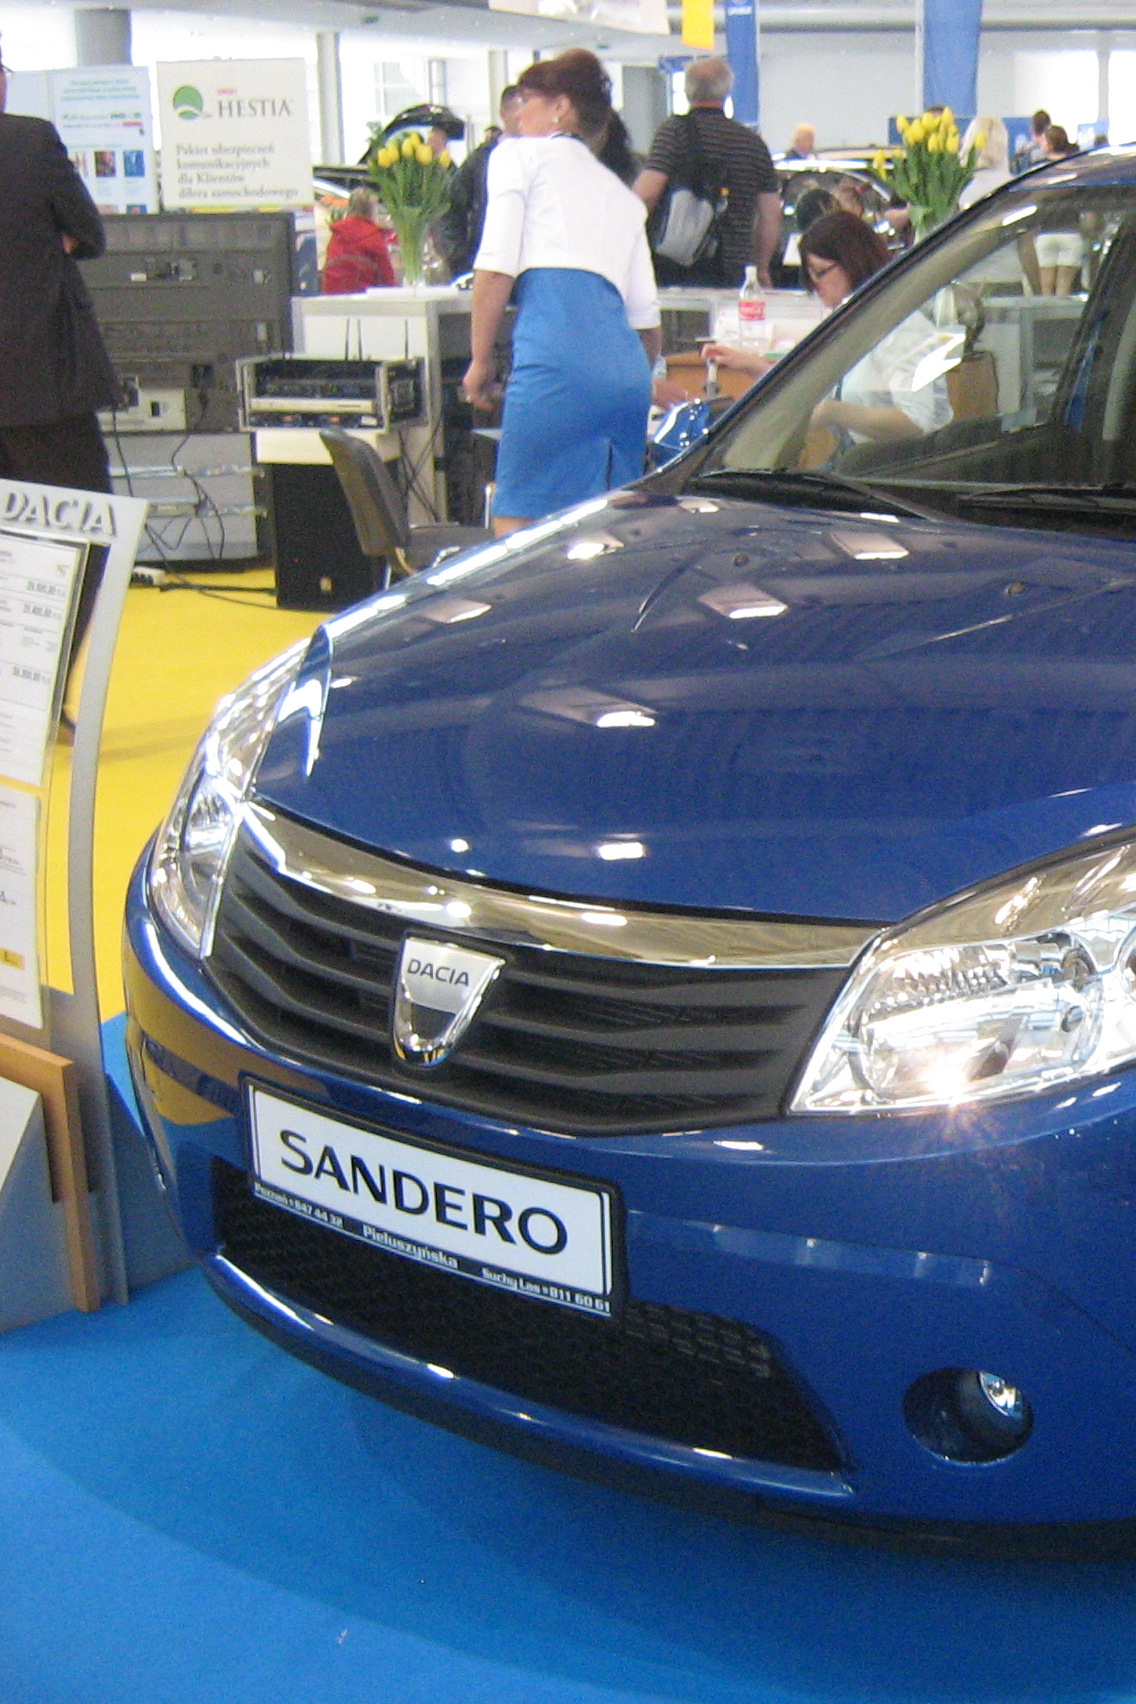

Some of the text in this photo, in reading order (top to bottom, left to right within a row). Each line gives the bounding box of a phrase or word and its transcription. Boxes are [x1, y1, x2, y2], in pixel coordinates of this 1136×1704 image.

[218, 99, 291, 117] HESTIA
[2, 491, 116, 537] DACIA
[407, 958, 470, 986] DACIA
[279, 1129, 568, 1255] SANDERO
